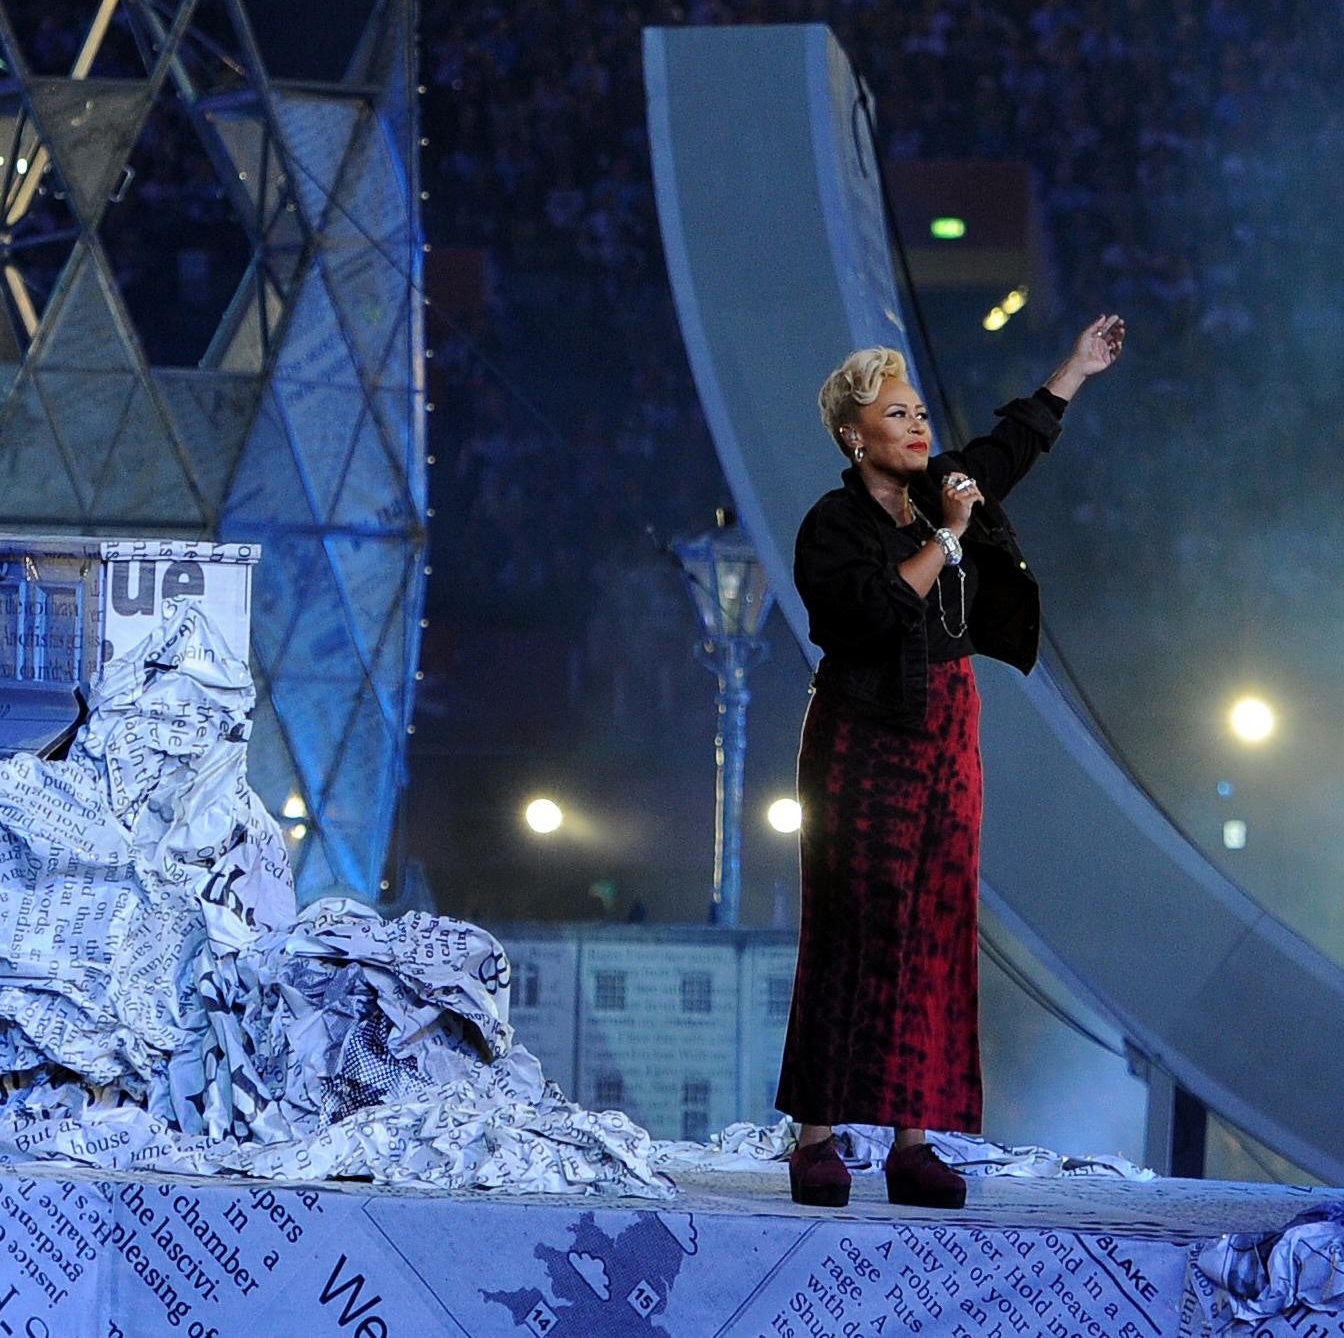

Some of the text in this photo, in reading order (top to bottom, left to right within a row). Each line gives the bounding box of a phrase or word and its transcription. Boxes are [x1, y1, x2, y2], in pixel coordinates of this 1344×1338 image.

[195, 705, 213, 738] the
[34, 882, 55, 935] words
[71, 906, 90, 936] that
[93, 901, 108, 921] on
[14, 1117, 83, 1153] But as
[69, 1127, 130, 1159] house
[0, 1189, 84, 1283] gredients
[38, 1195, 97, 1261] chalice
[74, 1195, 113, 1240] He's
[119, 1182, 220, 1303] the lascivi-
[222, 1201, 280, 1272] in a
[173, 1195, 259, 1296] chamber
[1031, 1260, 1045, 1278] a
[1095, 1232, 1159, 1303] BLAKE
[7, 1239, 69, 1309] justice
[104, 1221, 192, 1327] pleasing
[807, 1273, 845, 1322] with
[821, 1255, 887, 1335] rage. A
[839, 1237, 923, 1334] cage Puts
[875, 1240, 943, 1320] A robin
[941, 1273, 960, 1298] in
[959, 1298, 988, 1327] an
[969, 1266, 994, 1289] of
[1003, 1265, 1053, 1318] Hold
[1082, 1271, 1103, 1301] in
[1104, 1302, 1119, 1321] a
[530, 1307, 552, 1332] 14
[633, 1294, 654, 1312] 15
[981, 1286, 1030, 1334] your
